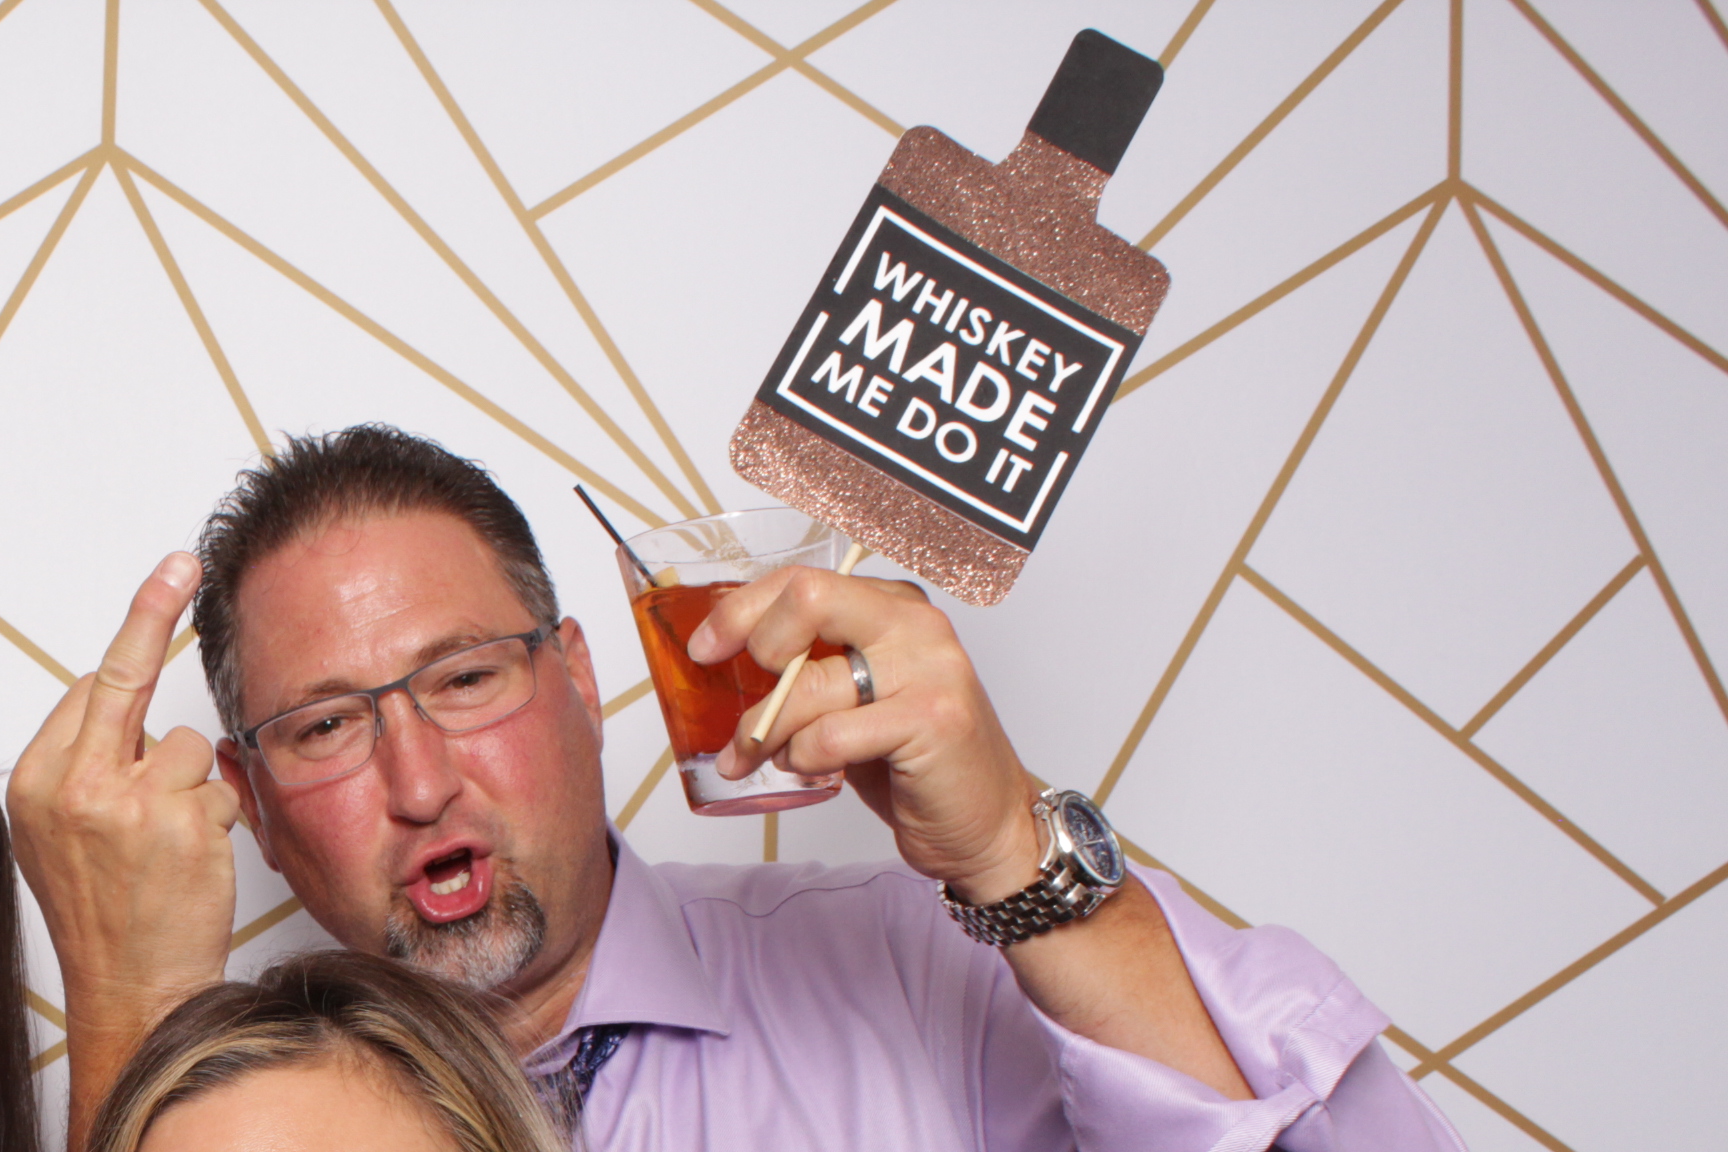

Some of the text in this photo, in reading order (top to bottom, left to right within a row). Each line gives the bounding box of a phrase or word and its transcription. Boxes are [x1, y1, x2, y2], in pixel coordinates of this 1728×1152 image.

[838, 298, 1057, 451] MADE
[873, 251, 1083, 393] WHISKEY
[810, 350, 1033, 492] ME DO IT
